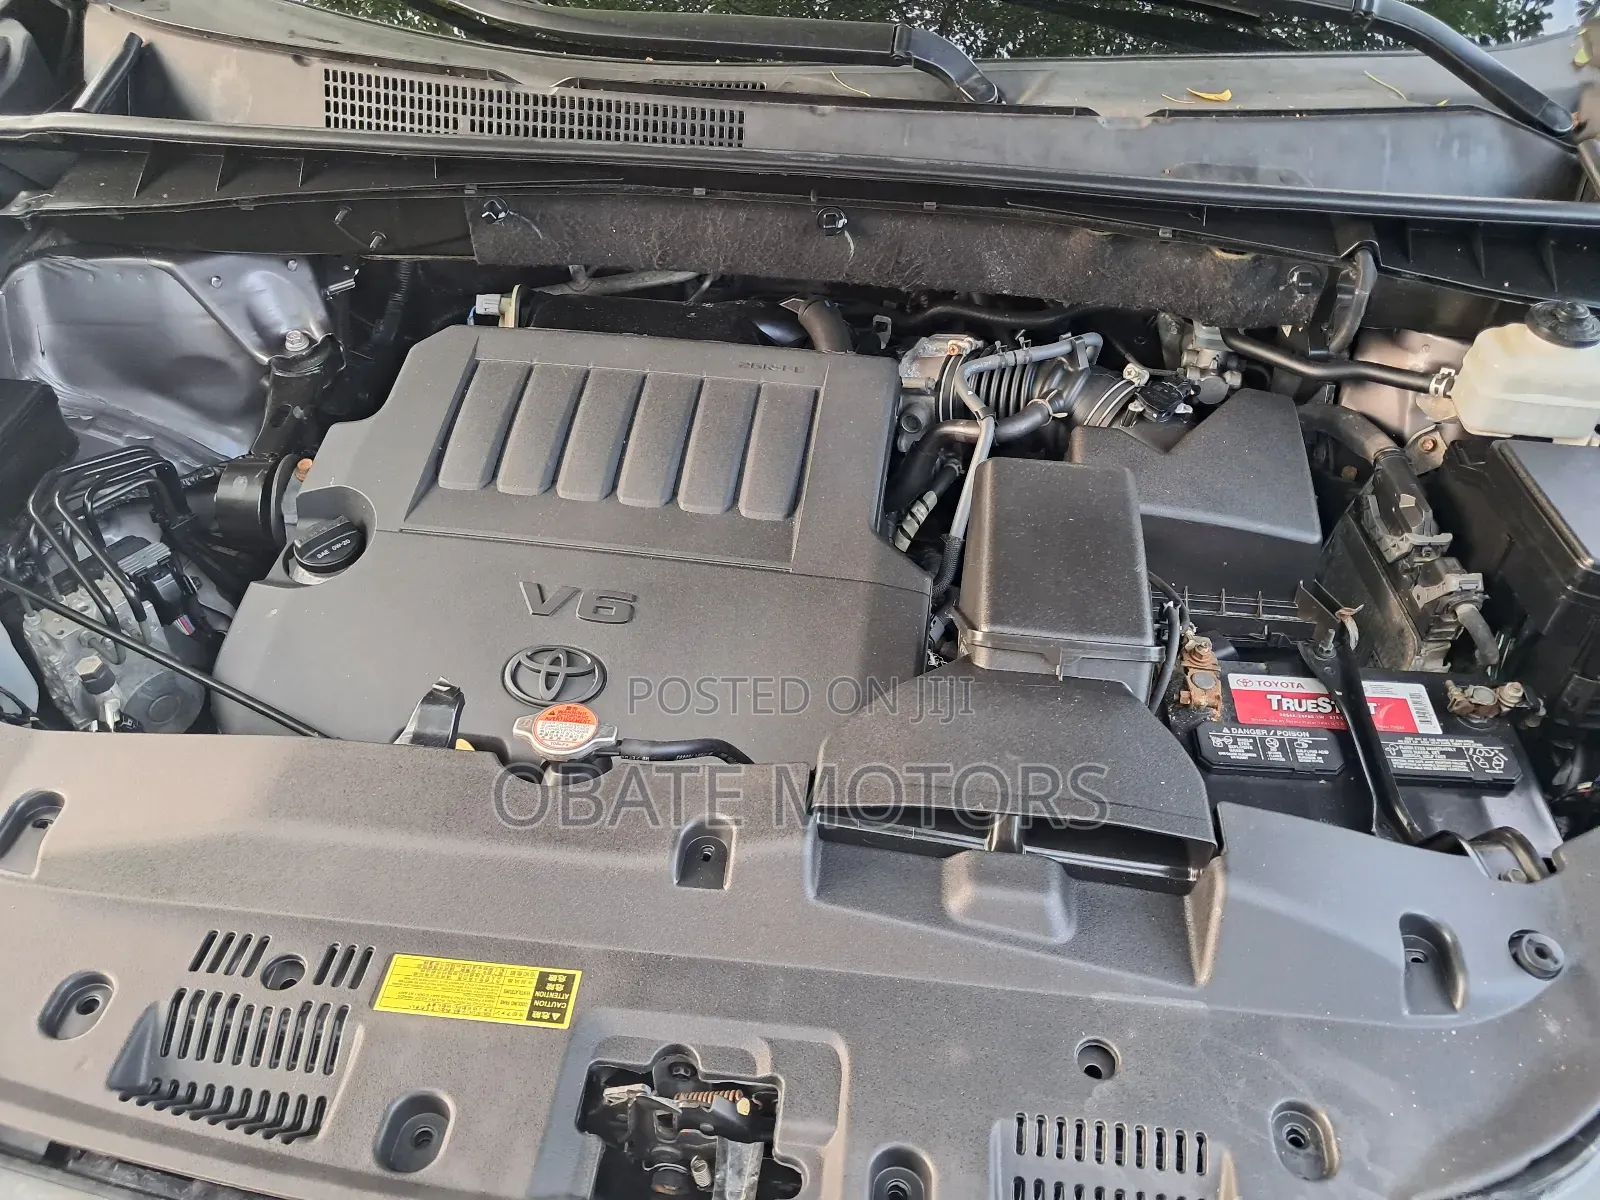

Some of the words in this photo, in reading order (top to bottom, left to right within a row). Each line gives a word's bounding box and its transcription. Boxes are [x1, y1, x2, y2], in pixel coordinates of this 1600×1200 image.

[316, 549, 331, 559] SAE
[331, 538, 351, 551] 0W-20
[518, 581, 637, 625] V6
[1257, 681, 1305, 689] TOYOTA
[1231, 727, 1268, 735] DANGER
[534, 990, 570, 1000] ATTENTION
[533, 1000, 567, 1009] CAUTION
